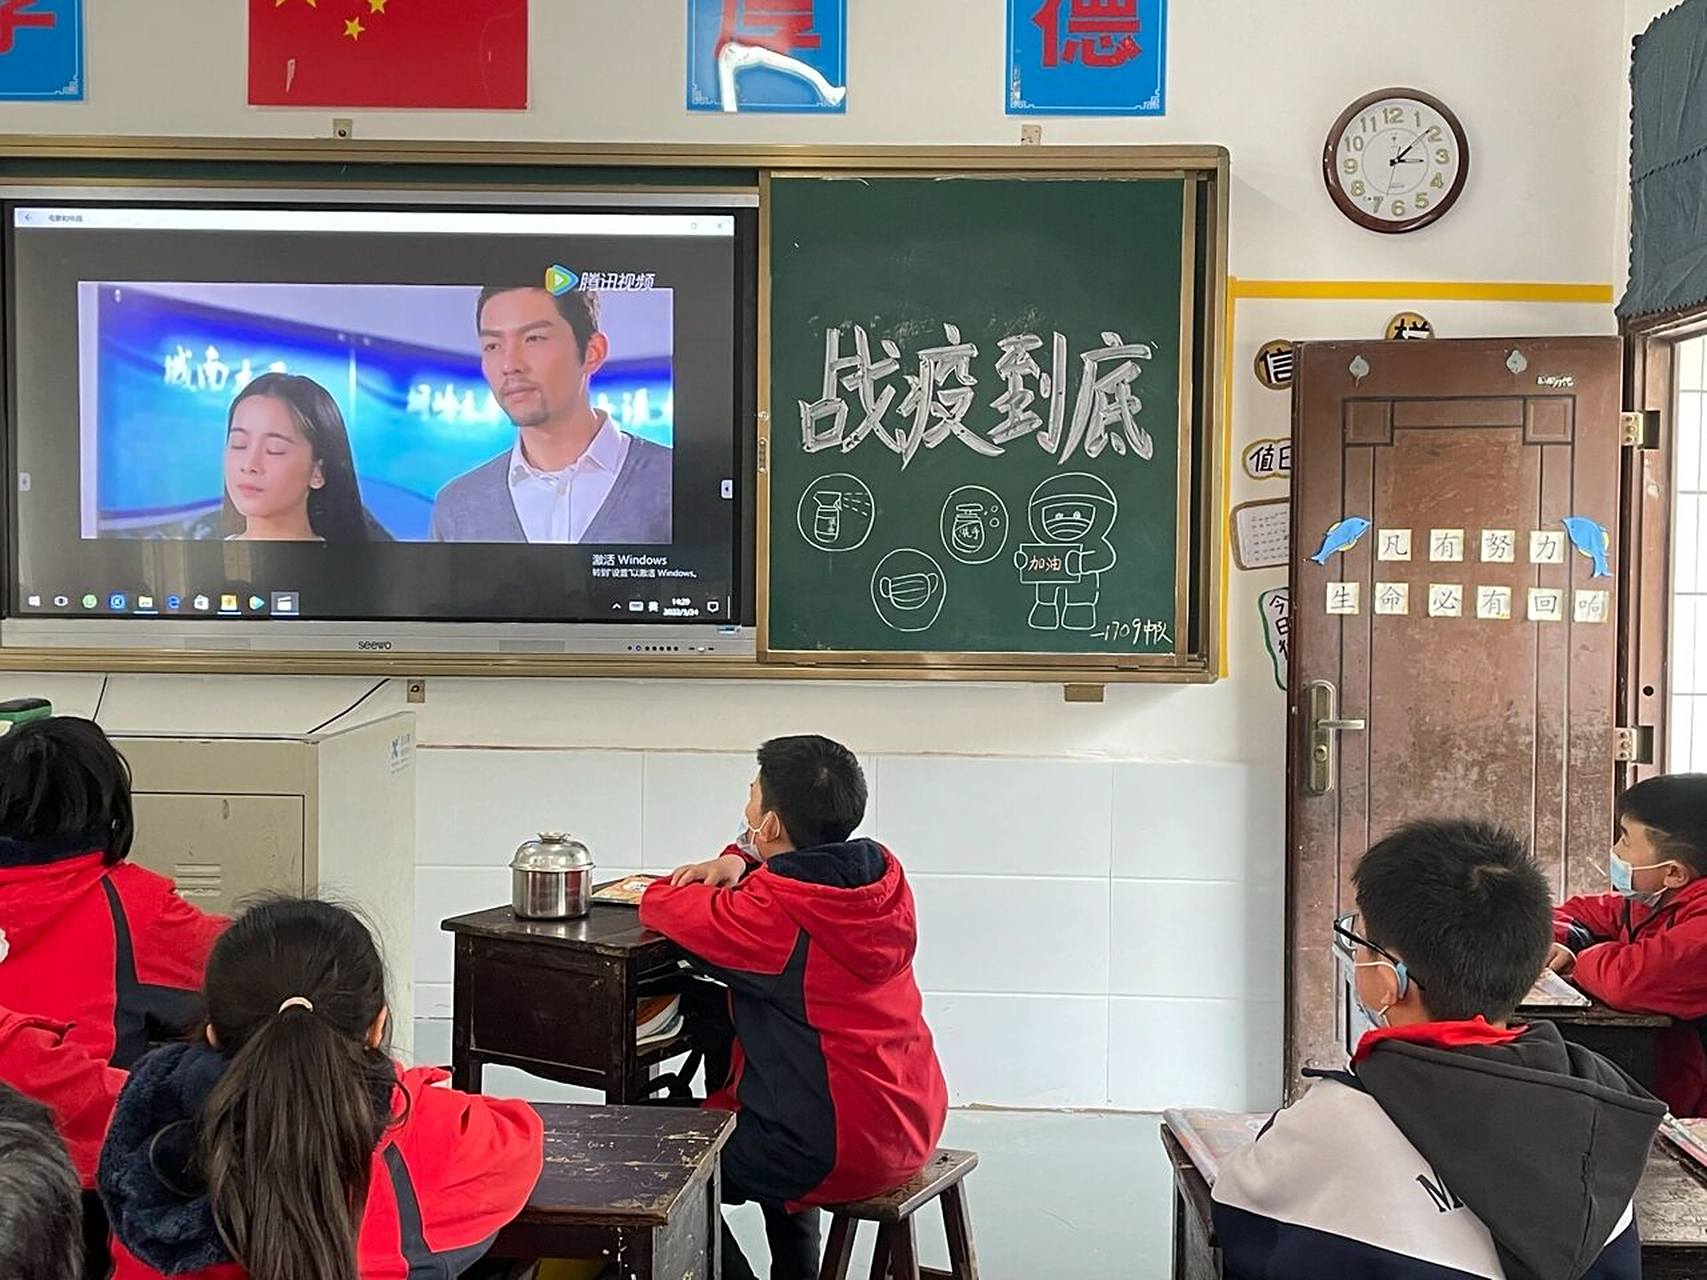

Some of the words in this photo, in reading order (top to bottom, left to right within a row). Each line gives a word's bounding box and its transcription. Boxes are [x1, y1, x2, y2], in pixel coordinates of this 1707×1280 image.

[1360, 116, 1377, 132] 11
[1382, 107, 1403, 125] 12
[1414, 111, 1421, 127] 1
[1427, 125, 1442, 142] 2
[1344, 135, 1364, 152] 10
[1435, 148, 1449, 164] 3
[1343, 158, 1358, 174] 9
[1350, 180, 1365, 196] 8
[1430, 172, 1443, 188] 4
[1391, 200, 1405, 216] 6
[1414, 192, 1430, 209] 5
[579, 271, 656, 291] 腾讯视频
[1260, 348, 1292, 384] 信
[798, 324, 1153, 470] 战疫到底
[1382, 532, 1557, 560] 凡有努力
[618, 555, 668, 566] Windows
[1028, 554, 1062, 572] 加油
[1330, 584, 1602, 614] 生命必有回响
[358, 640, 392, 650] seewo
